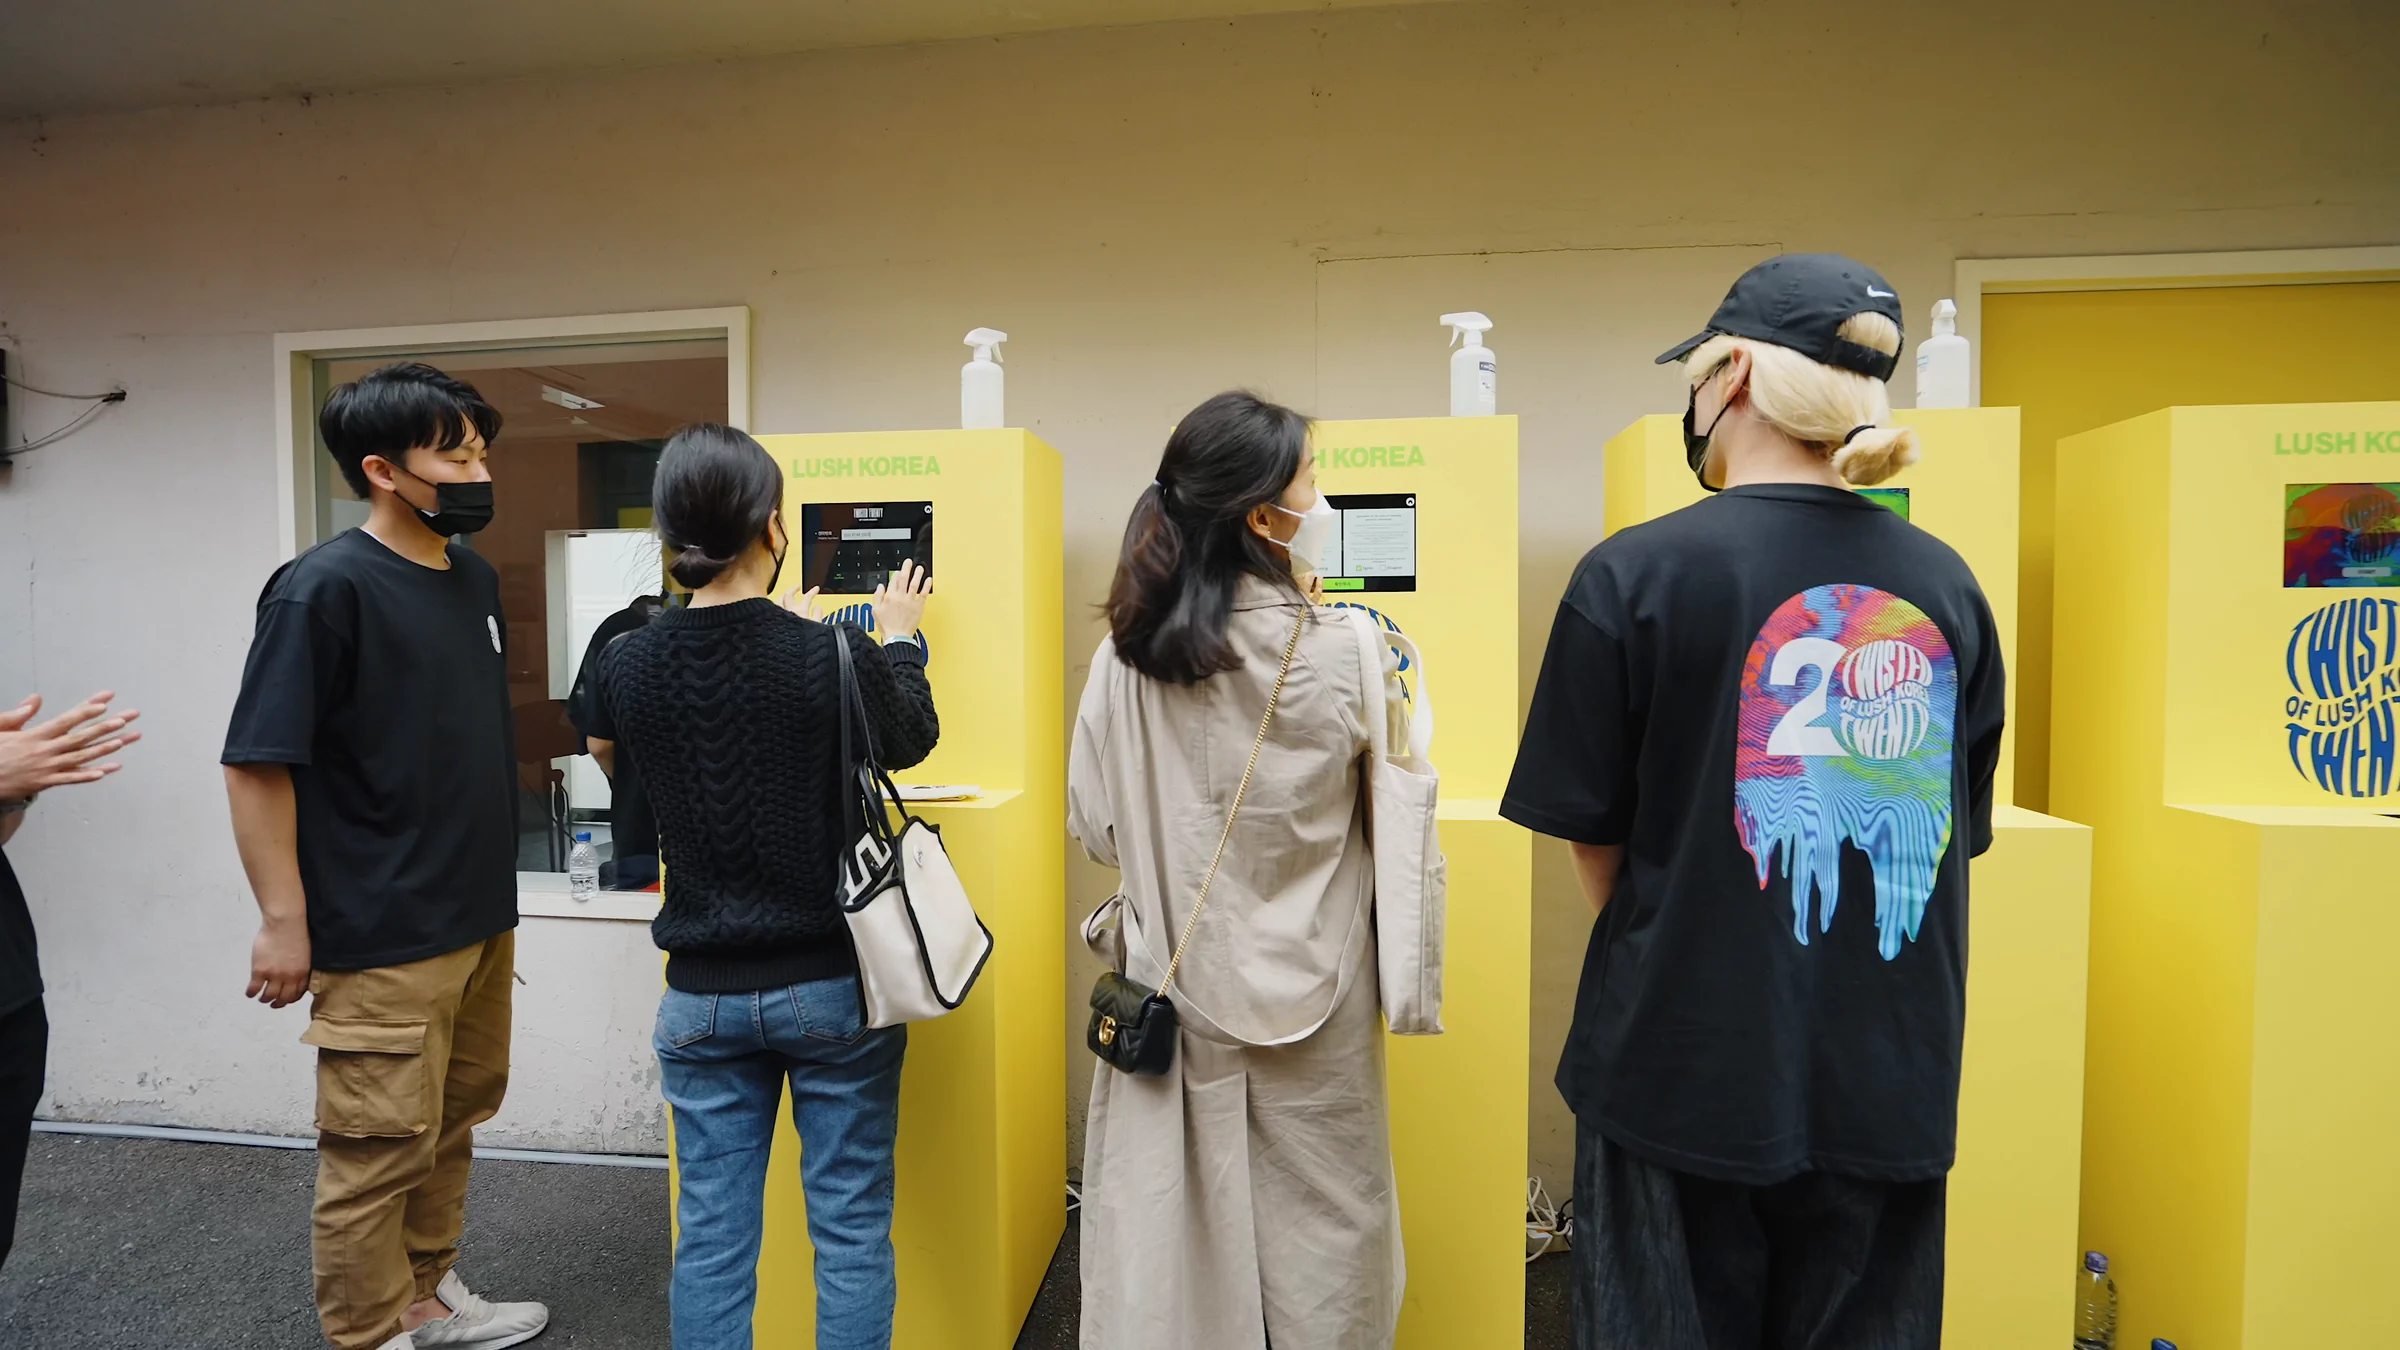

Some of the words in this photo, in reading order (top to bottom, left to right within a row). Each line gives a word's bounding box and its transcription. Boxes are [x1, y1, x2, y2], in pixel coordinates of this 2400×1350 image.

[2275, 432, 2356, 455] LUSH
[792, 458, 853, 478] LUSH
[858, 456, 941, 477] KOREA
[1333, 446, 1427, 469] KOREA
[1842, 640, 1933, 701] TWISTED
[1840, 696, 1857, 713] OF
[1857, 690, 1892, 717] LUSH
[2286, 696, 2312, 720] OF
[2316, 683, 2371, 727] LUSH
[2380, 669, 2400, 695] K
[1840, 700, 1930, 760] TWENTY
